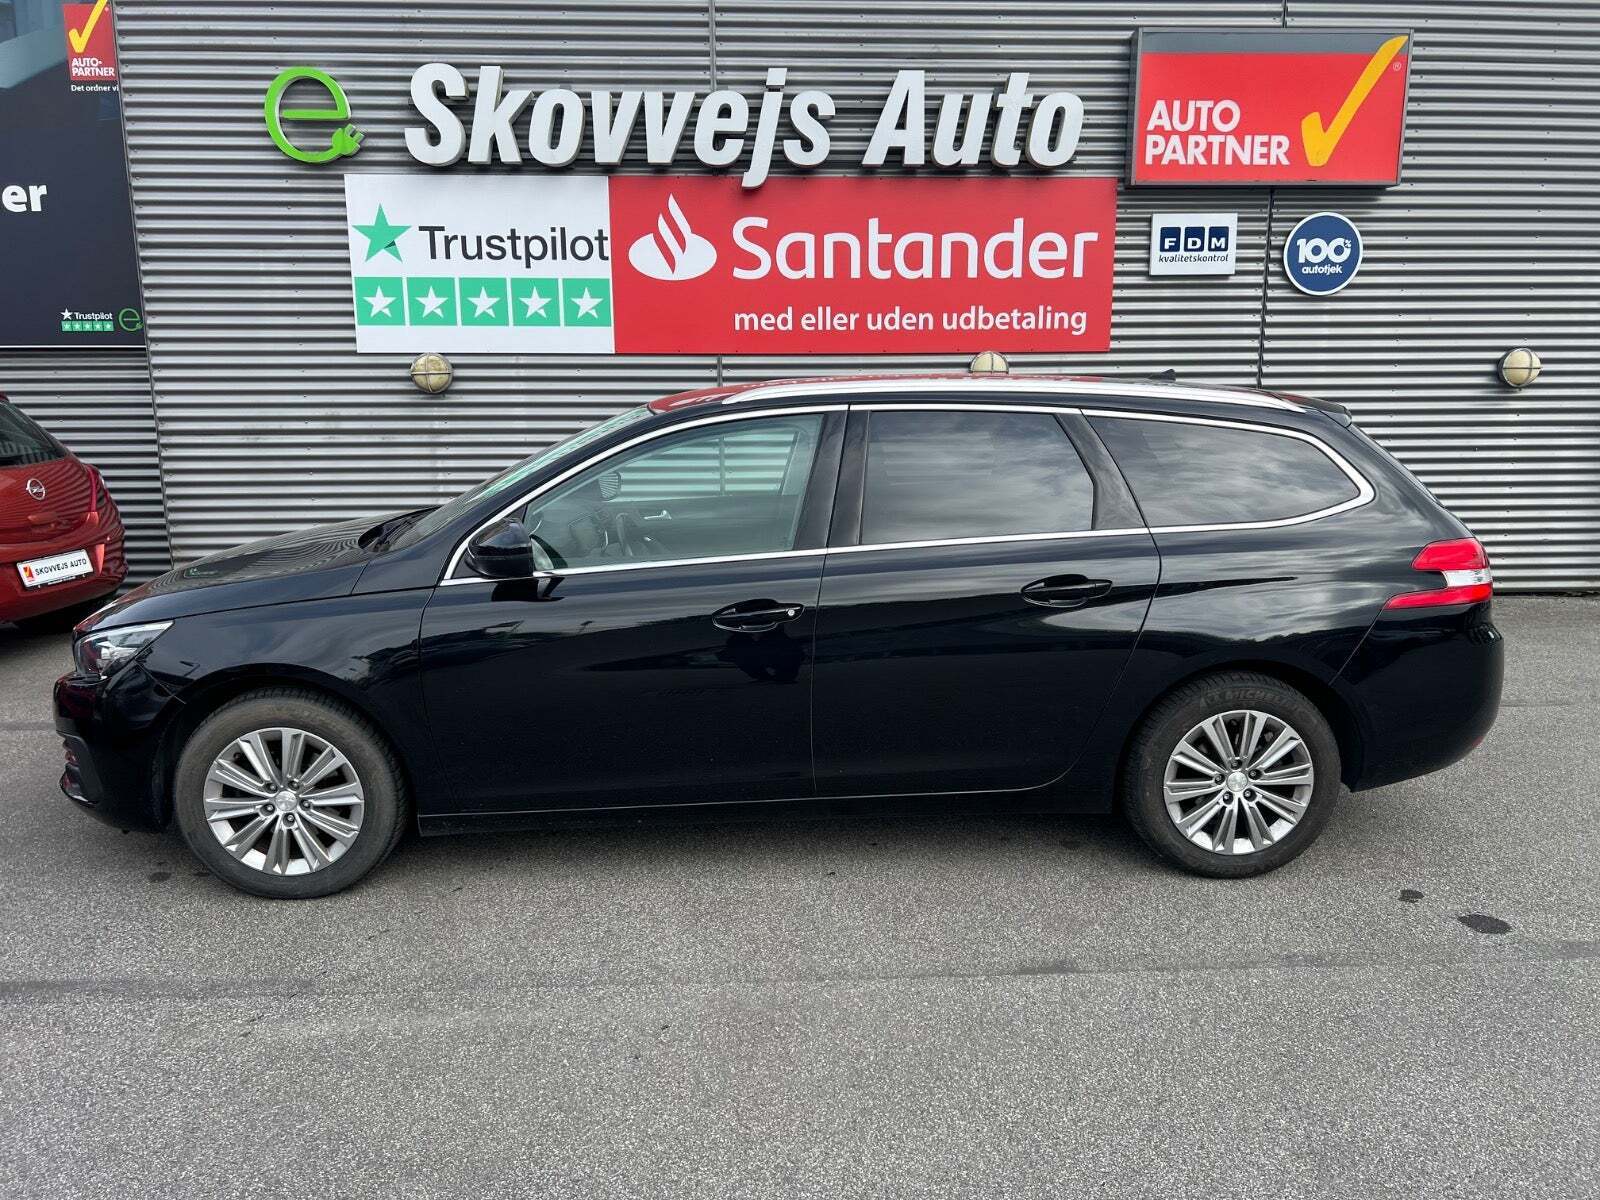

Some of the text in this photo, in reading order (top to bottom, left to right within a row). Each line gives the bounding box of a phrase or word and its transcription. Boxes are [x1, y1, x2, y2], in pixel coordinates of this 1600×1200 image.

[71, 57, 103, 68] AUTO-
[71, 66, 115, 77] PARTNER
[71, 84, 119, 92] Det ordner vi
[1146, 99, 1241, 133] AUTO
[404, 62, 1085, 189] Skovvejs Auto
[1145, 134, 1290, 166] PARTNER
[418, 225, 609, 269] Trustpilot
[732, 216, 1099, 280] Santander
[1163, 234, 1227, 250] FDM
[1158, 253, 1230, 264] kvalitetskontrol
[1301, 264, 1343, 275] autotjek
[74, 312, 113, 321] Trustpilot
[734, 305, 1087, 336] med eller uden udbetaling
[35, 558, 87, 576] SKOVVEJS AUTO
